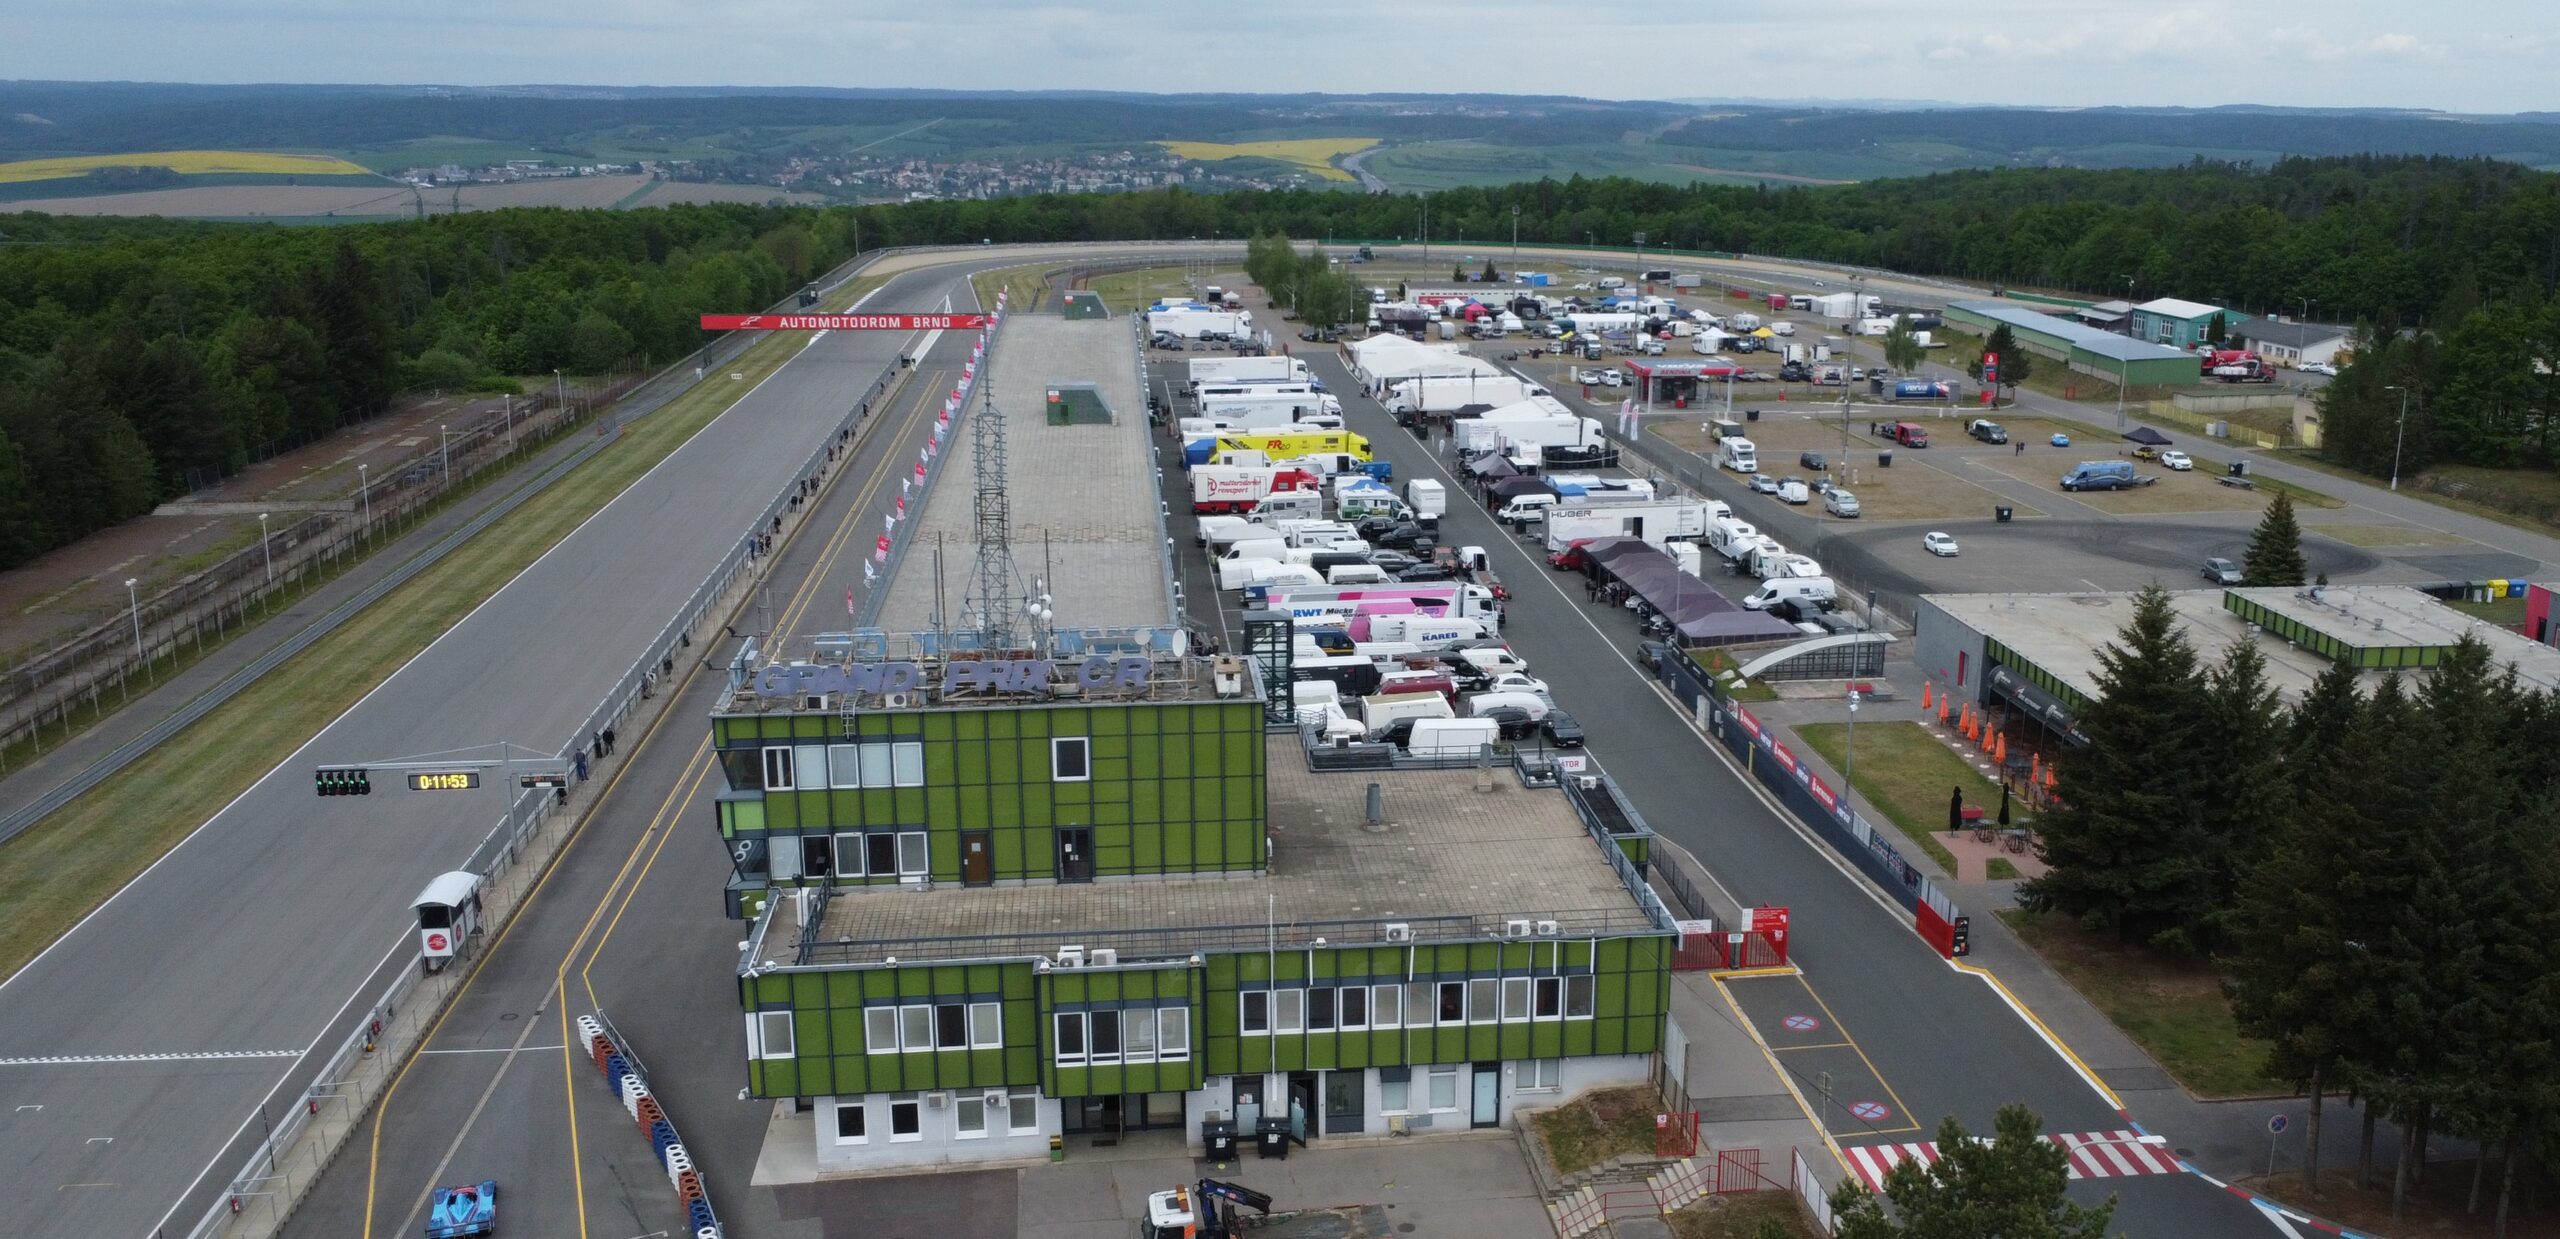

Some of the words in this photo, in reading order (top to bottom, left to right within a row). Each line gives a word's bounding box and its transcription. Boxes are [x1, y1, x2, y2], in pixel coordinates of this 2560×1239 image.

[780, 316, 901, 328] AUTOMOTODROM
[912, 316, 951, 328] BRNO
[1551, 510, 1592, 518] HUBER
[753, 662, 918, 697] GRAND
[944, 659, 1056, 692] PRIX
[1078, 656, 1152, 688] CR
[419, 774, 468, 789] 0:11:53
